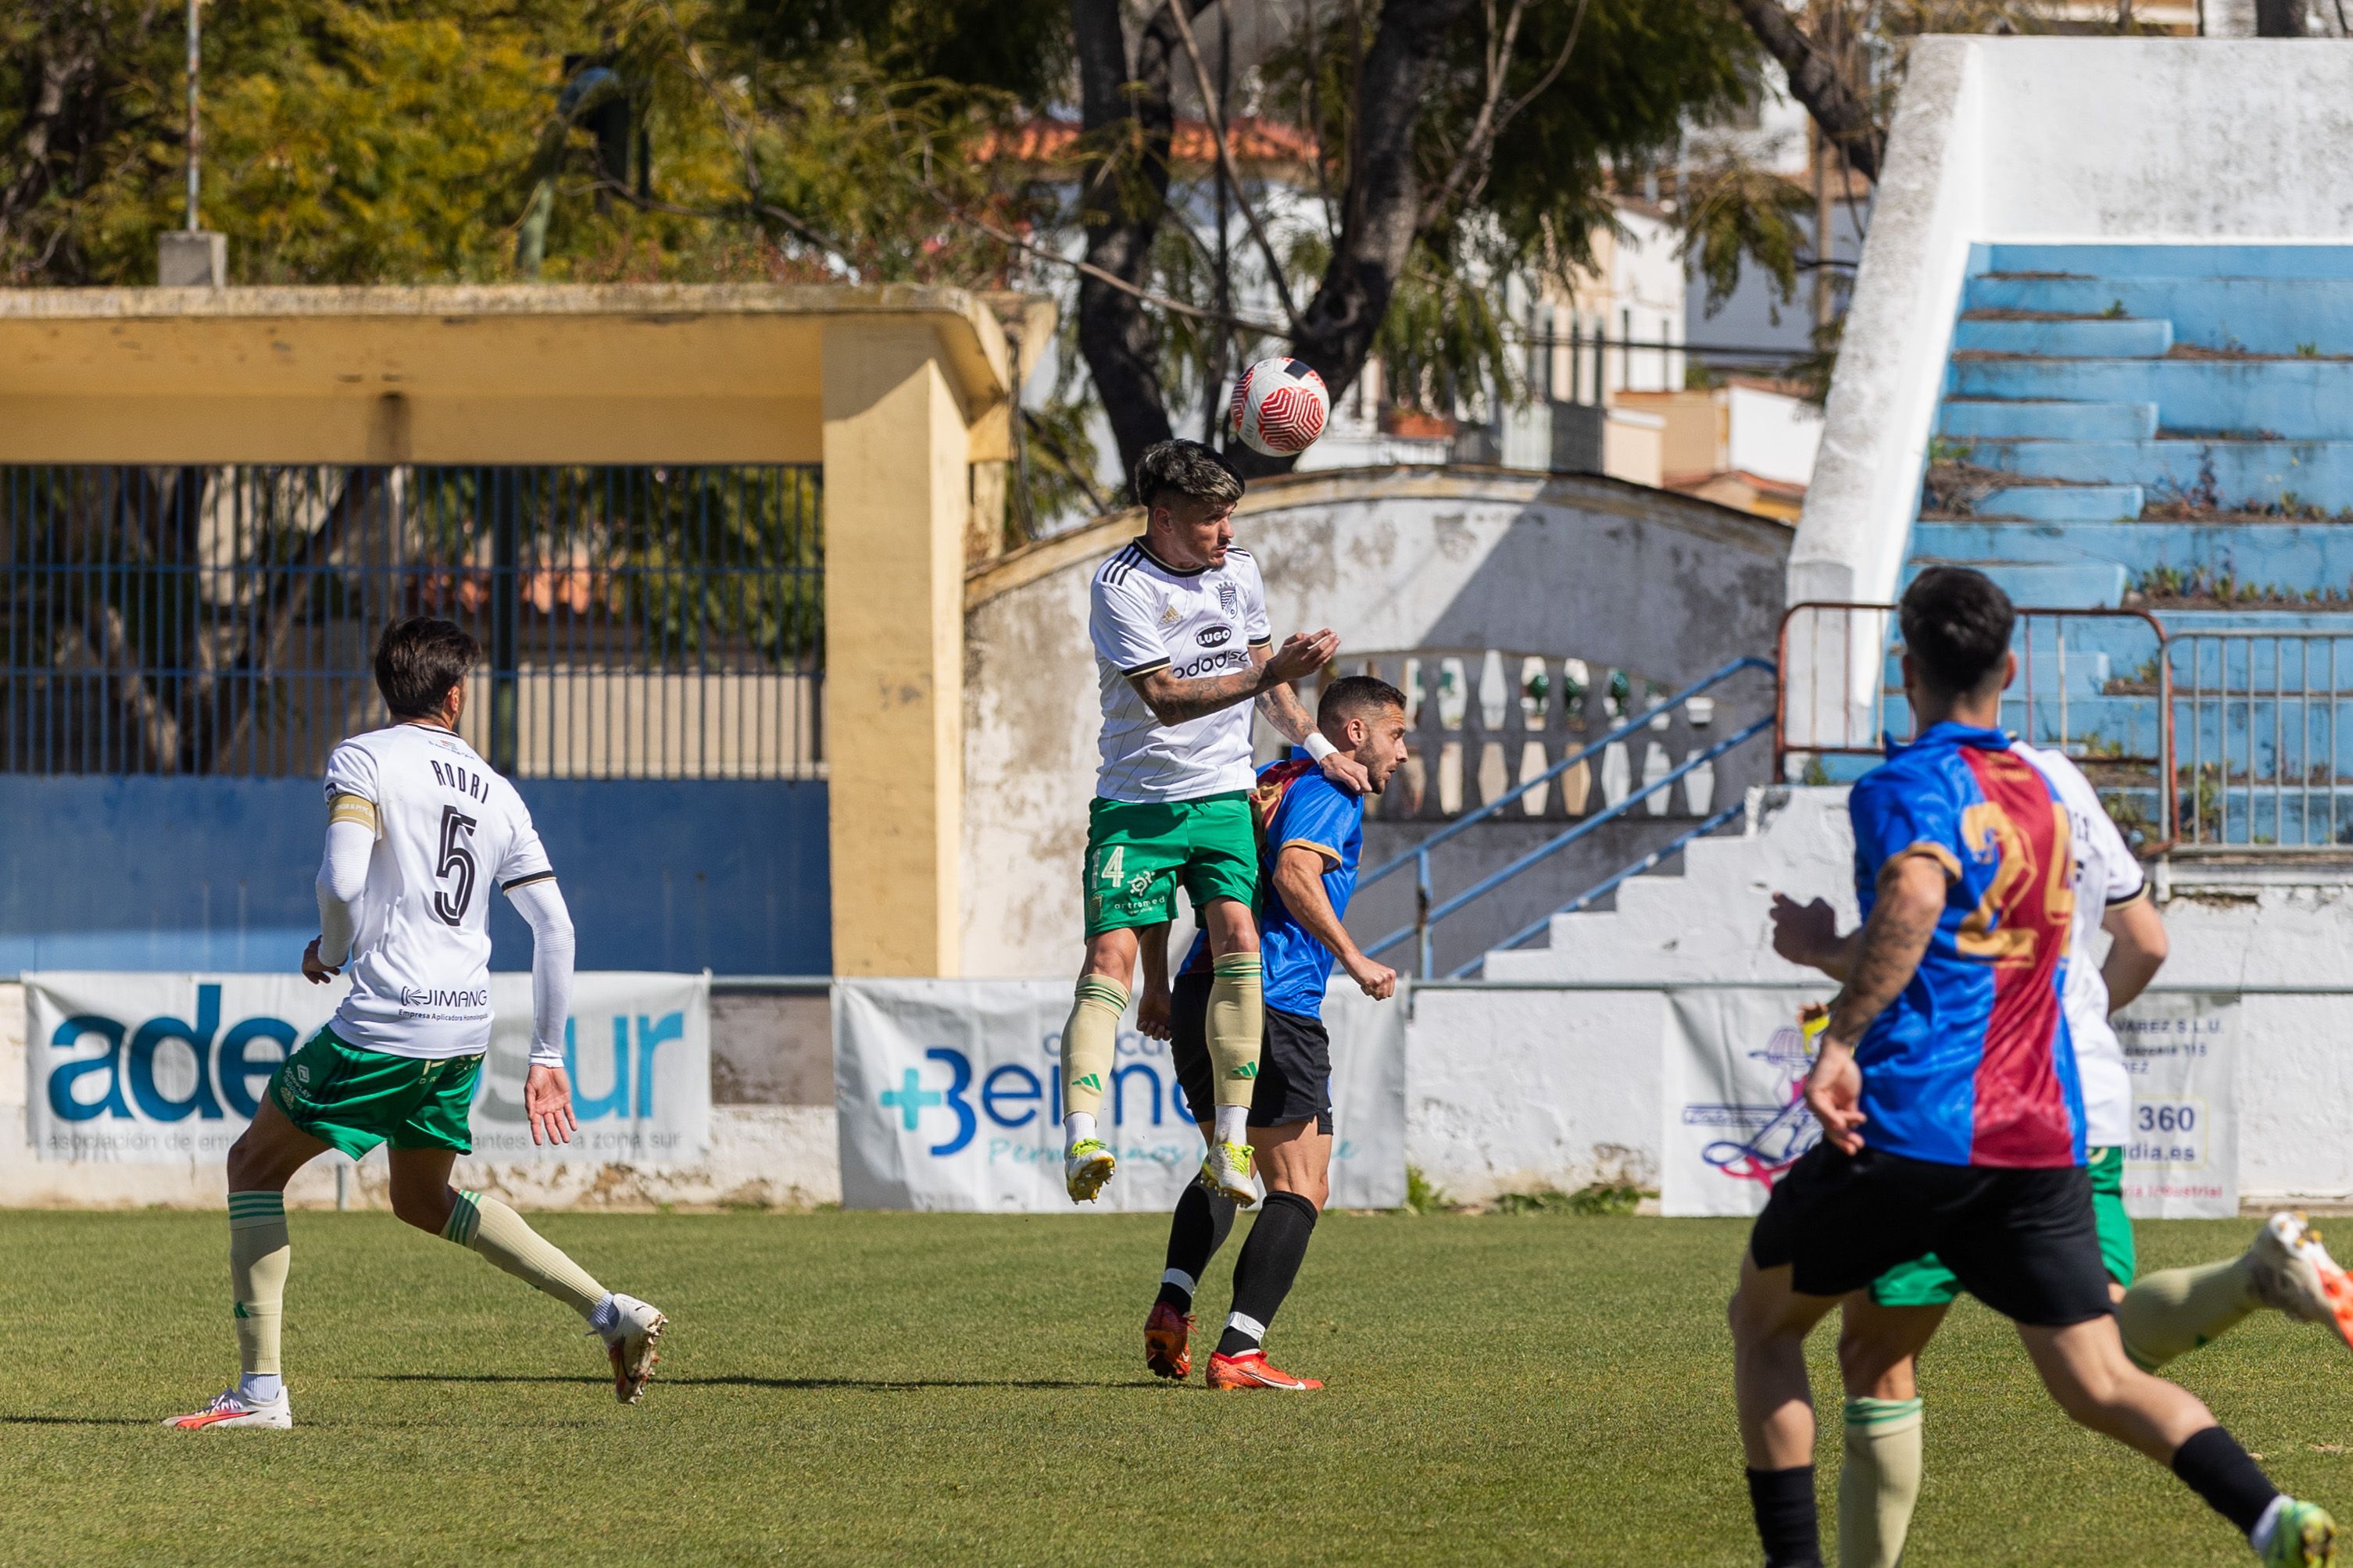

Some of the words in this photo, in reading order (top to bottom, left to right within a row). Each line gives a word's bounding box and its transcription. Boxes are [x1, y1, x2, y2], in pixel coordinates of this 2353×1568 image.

[1196, 629, 1231, 645] LUGO
[430, 760, 489, 805] RODRI
[434, 804, 477, 927] 5
[1114, 895, 1165, 909] artromed
[399, 1009, 431, 1020] Empresa
[431, 1013, 463, 1022] Aplicadora
[2113, 1019, 2171, 1034] VAREZ
[2138, 1105, 2196, 1132] 360
[649, 1133, 682, 1149] sur
